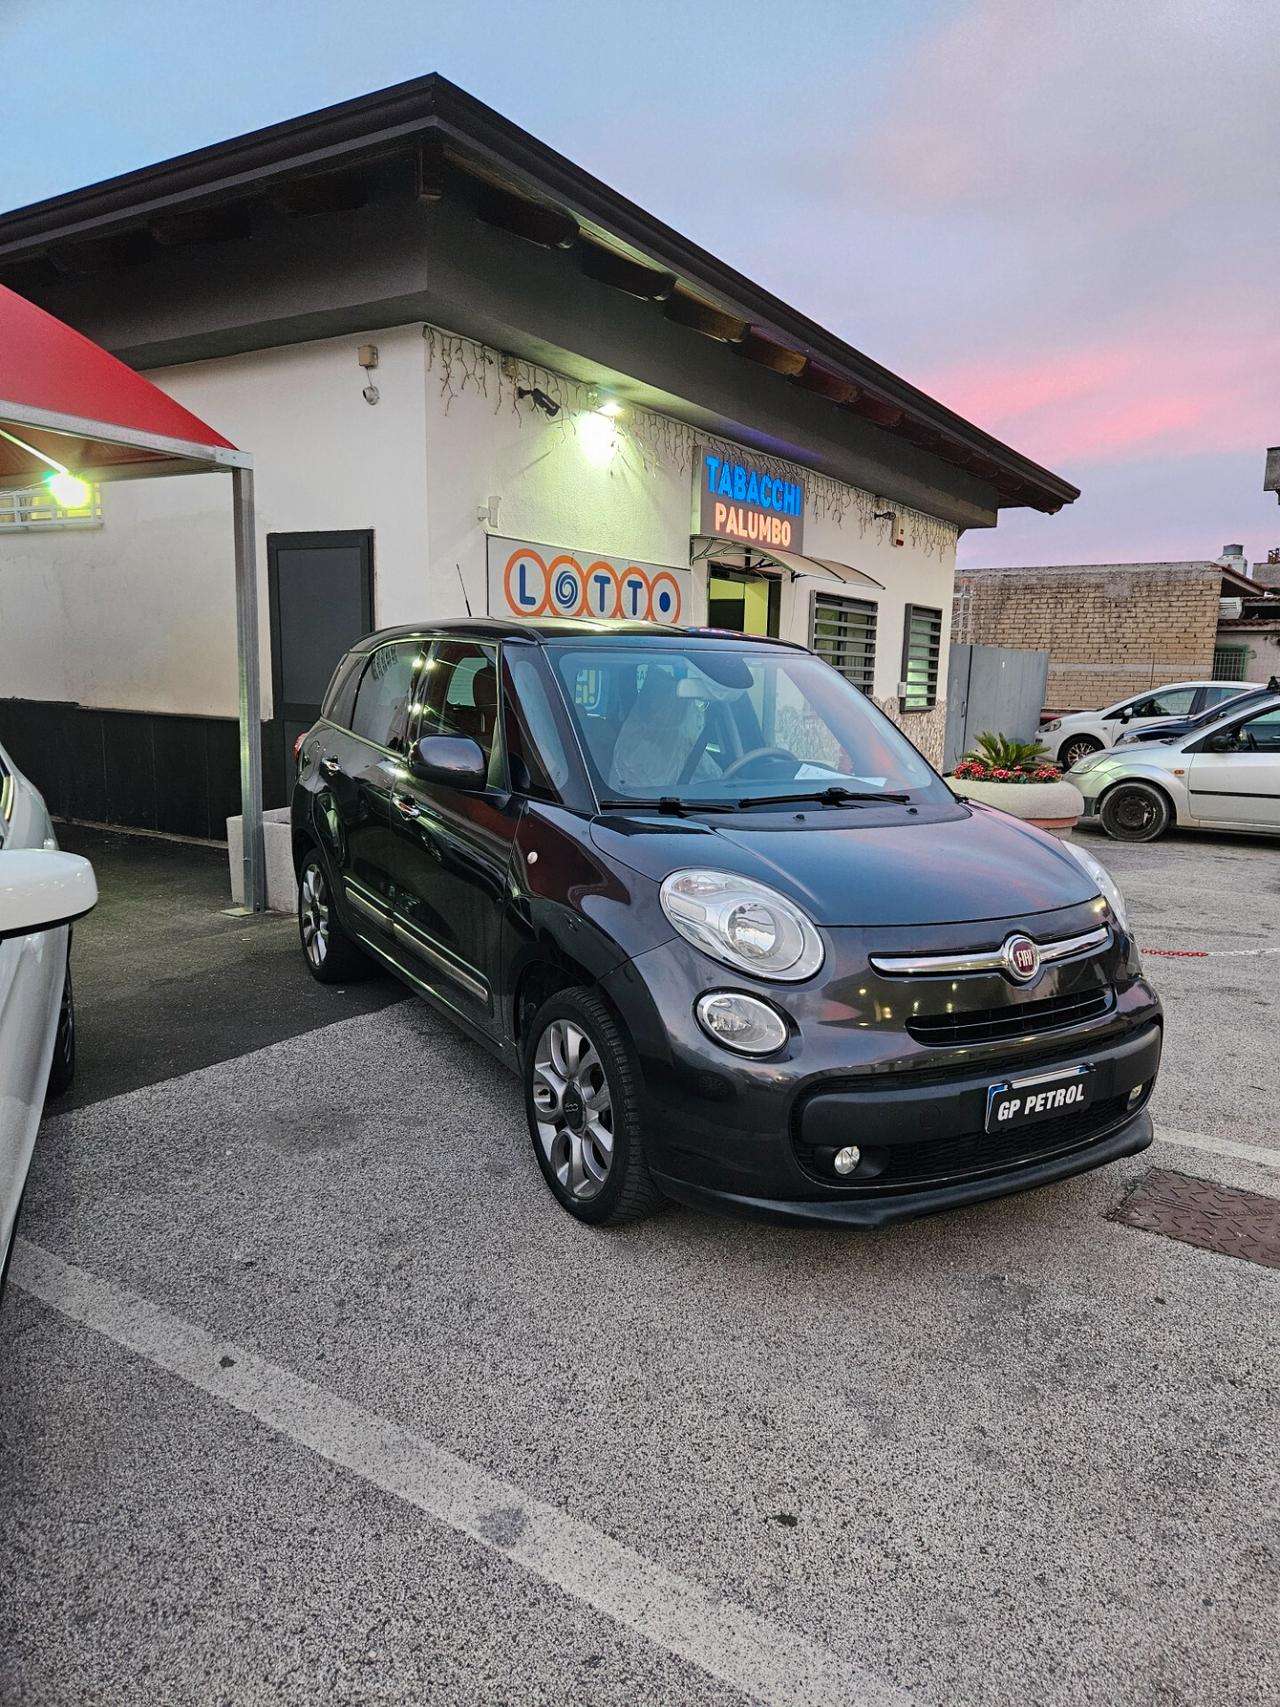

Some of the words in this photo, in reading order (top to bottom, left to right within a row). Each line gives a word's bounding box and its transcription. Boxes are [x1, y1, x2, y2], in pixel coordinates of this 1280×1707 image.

[705, 455, 801, 516] TABACCHI
[715, 502, 791, 547] PALUMBO
[517, 561, 673, 616] LOTTO
[1016, 949, 1033, 967] FIAT
[997, 1099, 1021, 1121] GP
[1024, 1083, 1084, 1115] PETROL
